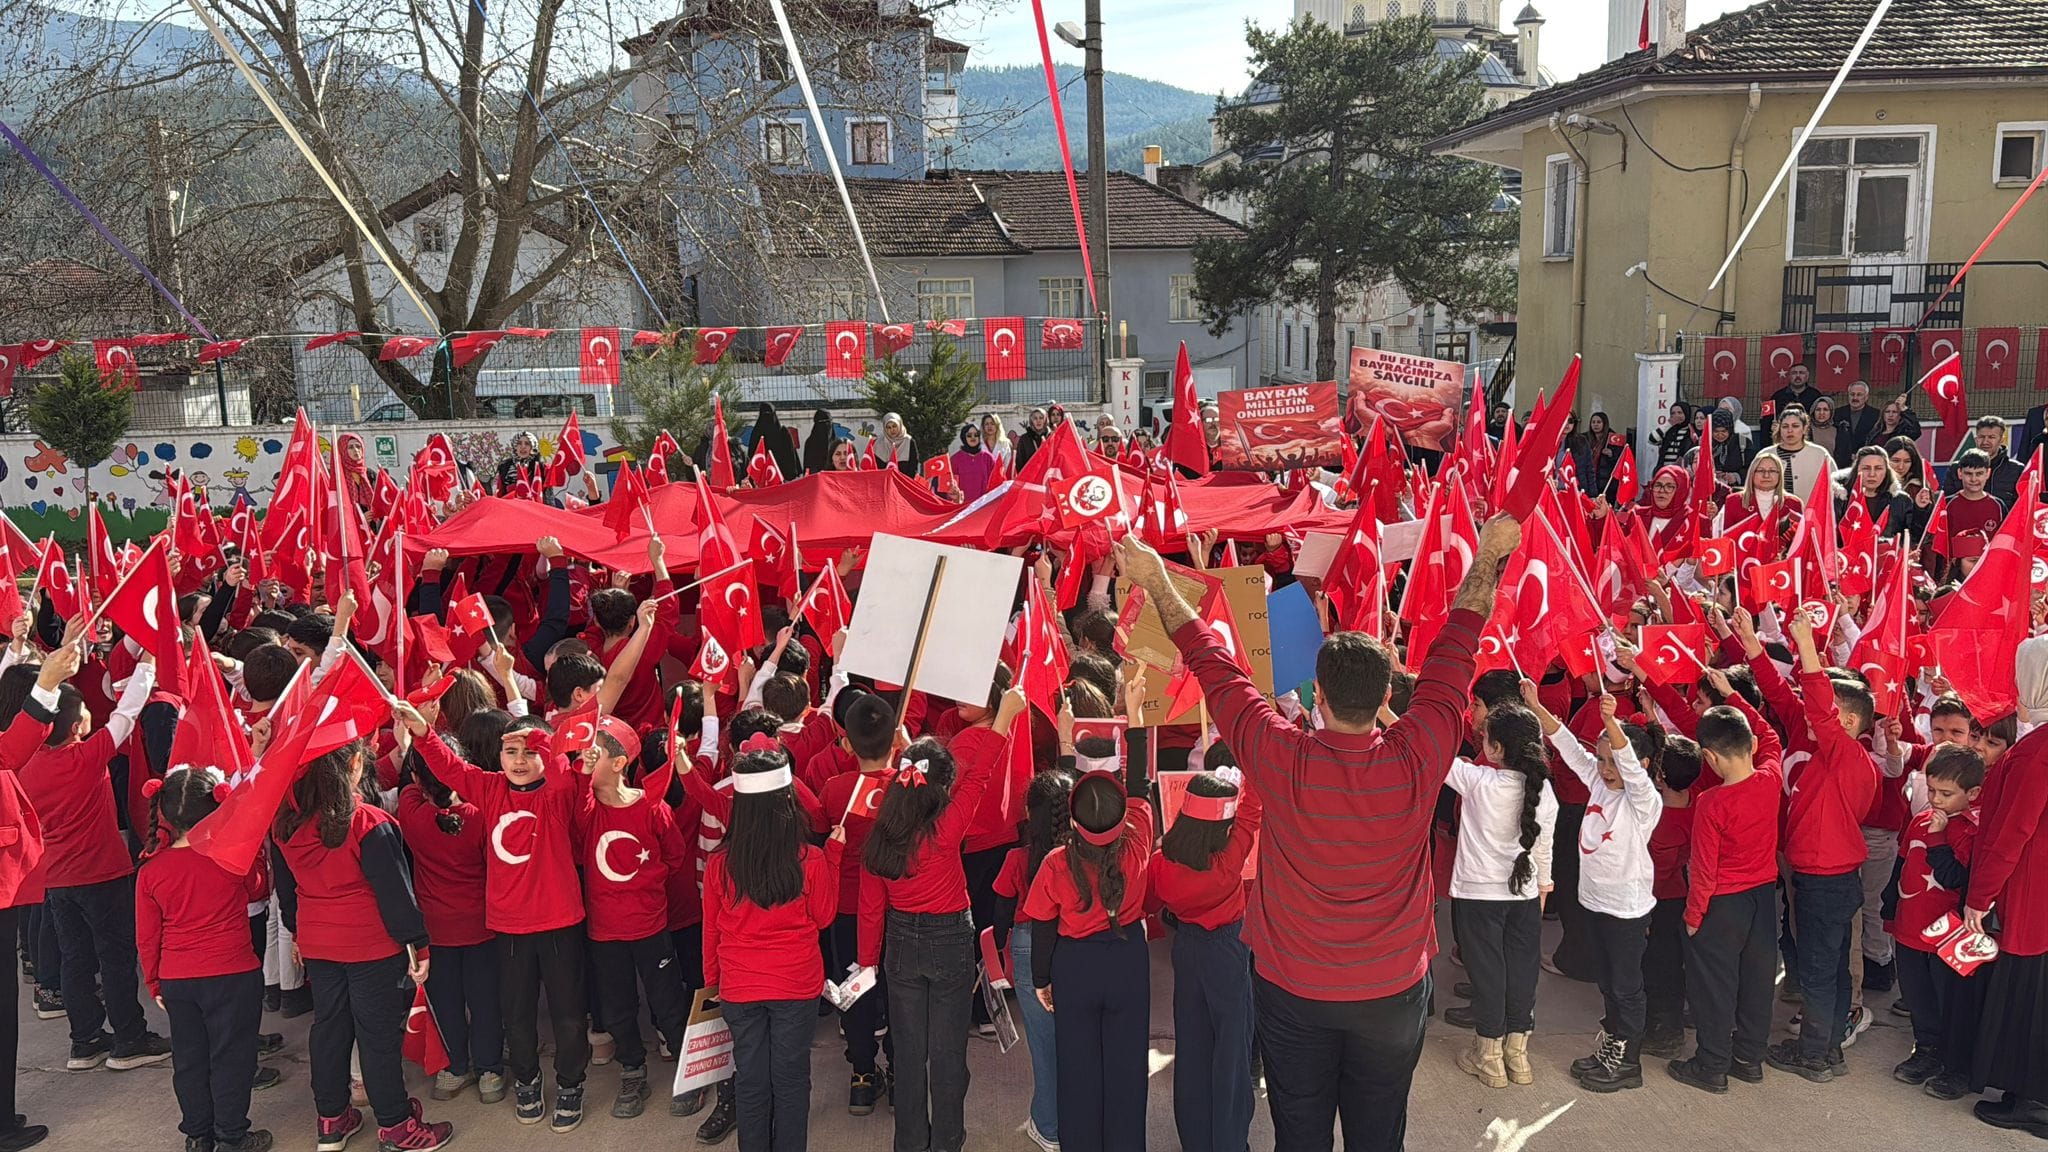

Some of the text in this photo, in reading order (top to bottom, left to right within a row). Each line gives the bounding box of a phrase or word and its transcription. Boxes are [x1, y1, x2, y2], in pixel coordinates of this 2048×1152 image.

[1380, 354, 1435, 369] BU ELLER
[1359, 359, 1453, 381] BAYRAĞIMIZA
[1373, 370, 1435, 389] SAYGILI
[1243, 386, 1309, 402] BAYRAK
[1236, 405, 1315, 419] ONURUDUR
